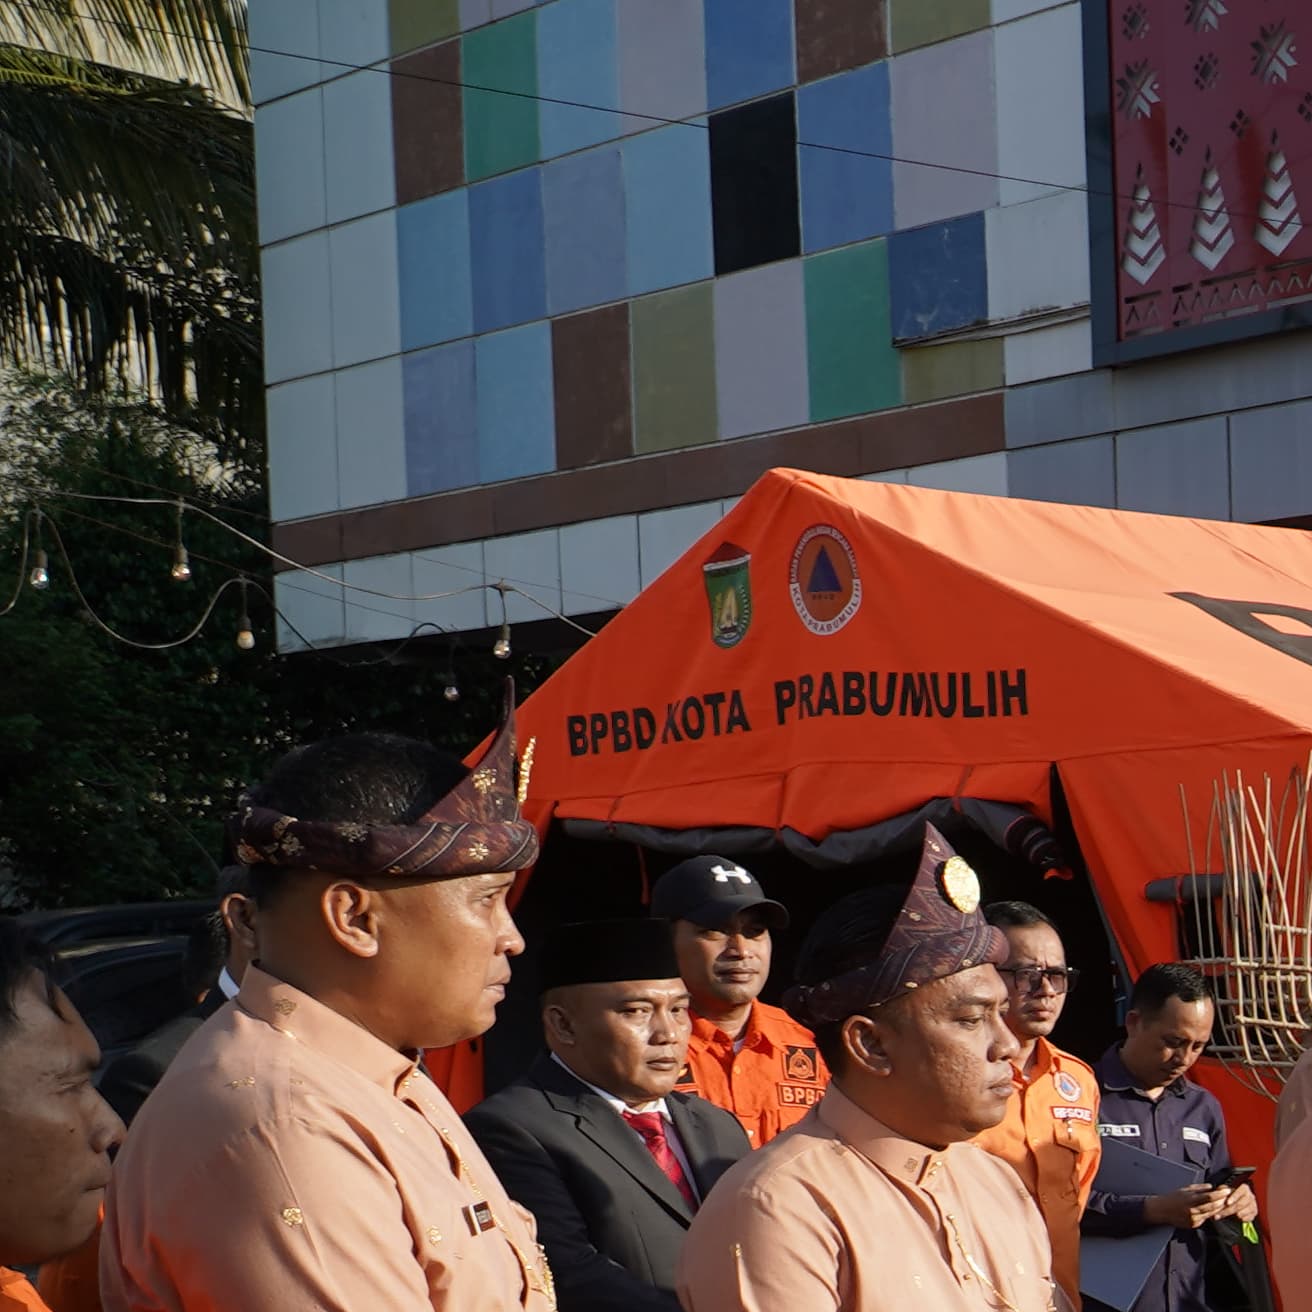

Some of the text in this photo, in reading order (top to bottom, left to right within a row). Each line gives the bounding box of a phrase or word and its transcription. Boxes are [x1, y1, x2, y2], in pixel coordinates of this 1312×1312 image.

[568, 669, 1029, 757] BPBD KOTA PRABUMULIH
